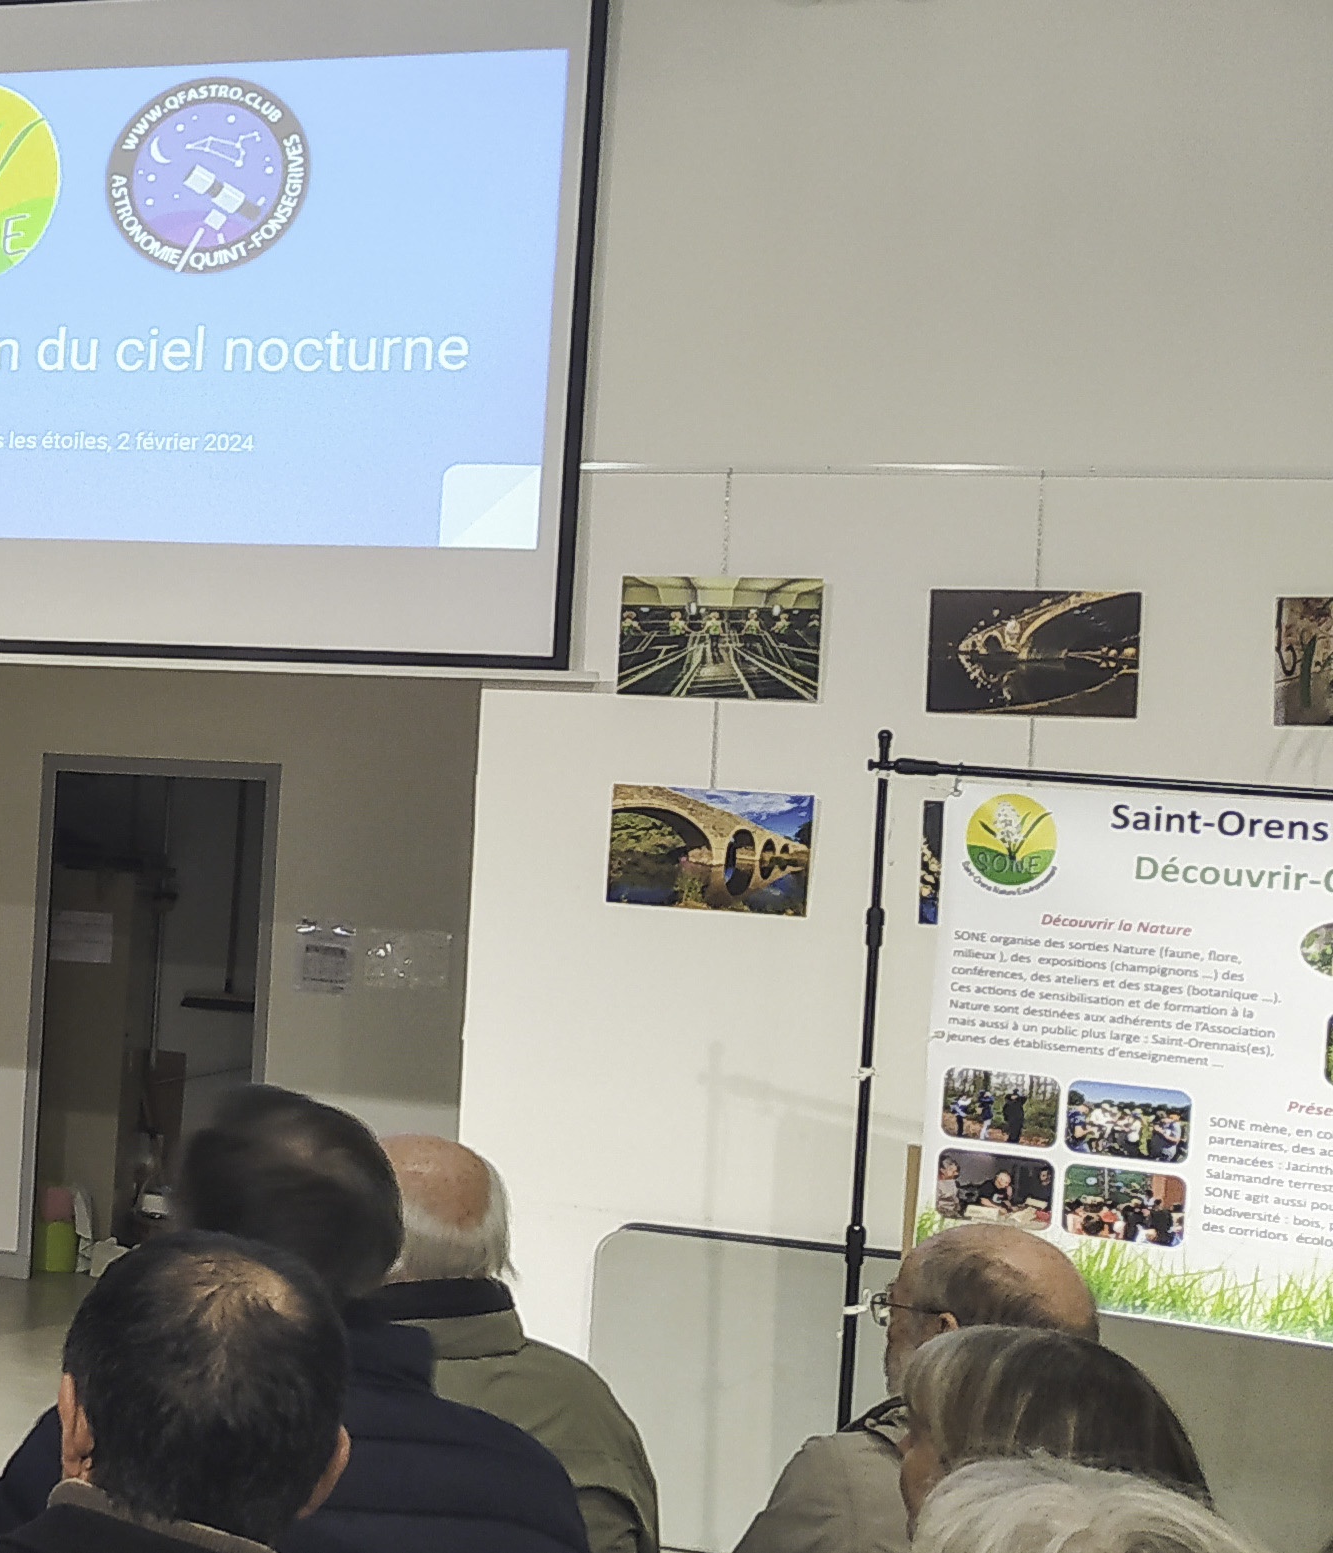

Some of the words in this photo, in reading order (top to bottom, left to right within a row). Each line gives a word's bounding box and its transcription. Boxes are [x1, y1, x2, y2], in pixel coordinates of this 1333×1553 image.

[122, 84, 283, 150] WWW.QFASTRO.CLUB
[111, 174, 183, 264] ASTRONOMIE
[37, 326, 99, 373] du
[116, 324, 204, 372] ciel
[224, 327, 469, 373] nocturne
[9, 430, 36, 450] les
[41, 430, 112, 453] étoiles,
[116, 433, 130, 450] 2
[135, 431, 197, 450] février
[204, 434, 255, 452] 2024
[1110, 805, 1329, 842] Saint-Orens
[976, 851, 1042, 874] SONE
[1041, 914, 1115, 931] Découvrir
[1118, 919, 1132, 932] la
[1137, 922, 1193, 937] Nature
[954, 930, 987, 943] SONE
[990, 934, 1041, 947] organise
[1044, 938, 1065, 949] des
[1069, 940, 1109, 953] sorties
[1113, 943, 1156, 956] Nature
[1159, 946, 1204, 962] (faune,
[1208, 950, 1243, 965] flore,
[953, 949, 996, 960] milieux
[1011, 953, 1032, 963] des
[1038, 955, 1107, 970] expositions
[1110, 960, 1199, 978] (champignons
[1222, 970, 1245, 982] des
[951, 965, 1027, 982] conférences,
[1030, 972, 1051, 983] des
[1054, 974, 1099, 987] ateliers
[1102, 979, 1115, 988] et
[1119, 979, 1140, 991] des
[1144, 982, 1183, 995] stages
[1186, 985, 1259, 1002] (botanique
[950, 982, 971, 993] Ces
[974, 985, 1017, 998] actions
[1020, 988, 1035, 999] de
[1039, 991, 1124, 1008] sensibilisation
[1128, 998, 1141, 1009] et
[1144, 999, 1160, 1010] de
[1163, 1000, 1228, 1016] formation
[1231, 1007, 1239, 1017] à
[1242, 1007, 1254, 1019] la
[949, 999, 991, 1012] Nature
[994, 1004, 1020, 1015] sont
[1023, 1007, 1081, 1021] destinées
[1083, 1013, 1106, 1023] aux
[1108, 1015, 1172, 1030] adhérents
[1175, 1020, 1192, 1031] de
[948, 1016, 976, 1027] mais
[979, 1020, 1009, 1030] aussi
[1012, 1021, 1019, 1031] à
[1022, 1024, 1038, 1033] un
[1041, 1024, 1078, 1037] public
[1081, 1029, 1106, 1040] plus
[1110, 1031, 1140, 1044] large
[946, 1032, 986, 1044] jeunes
[989, 1035, 1010, 1046] des
[1013, 1037, 1105, 1056] établissements
[1108, 1046, 1208, 1066] d'enseignement
[1209, 1116, 1245, 1131] SONE
[1250, 1123, 1291, 1137] mène,
[1296, 1128, 1312, 1138] en
[1208, 1135, 1288, 1153] partenaires,
[1291, 1143, 1315, 1156] des
[1207, 1153, 1273, 1169] menacées
[1205, 1168, 1284, 1187] Salamandre
[1204, 1186, 1241, 1200] SONE
[1245, 1193, 1269, 1204] agit
[1273, 1195, 1306, 1208] aussi
[1203, 1204, 1280, 1224] biodiversité
[1293, 1215, 1325, 1230] bois,
[1202, 1222, 1225, 1233] des
[1228, 1226, 1288, 1242] corridors
